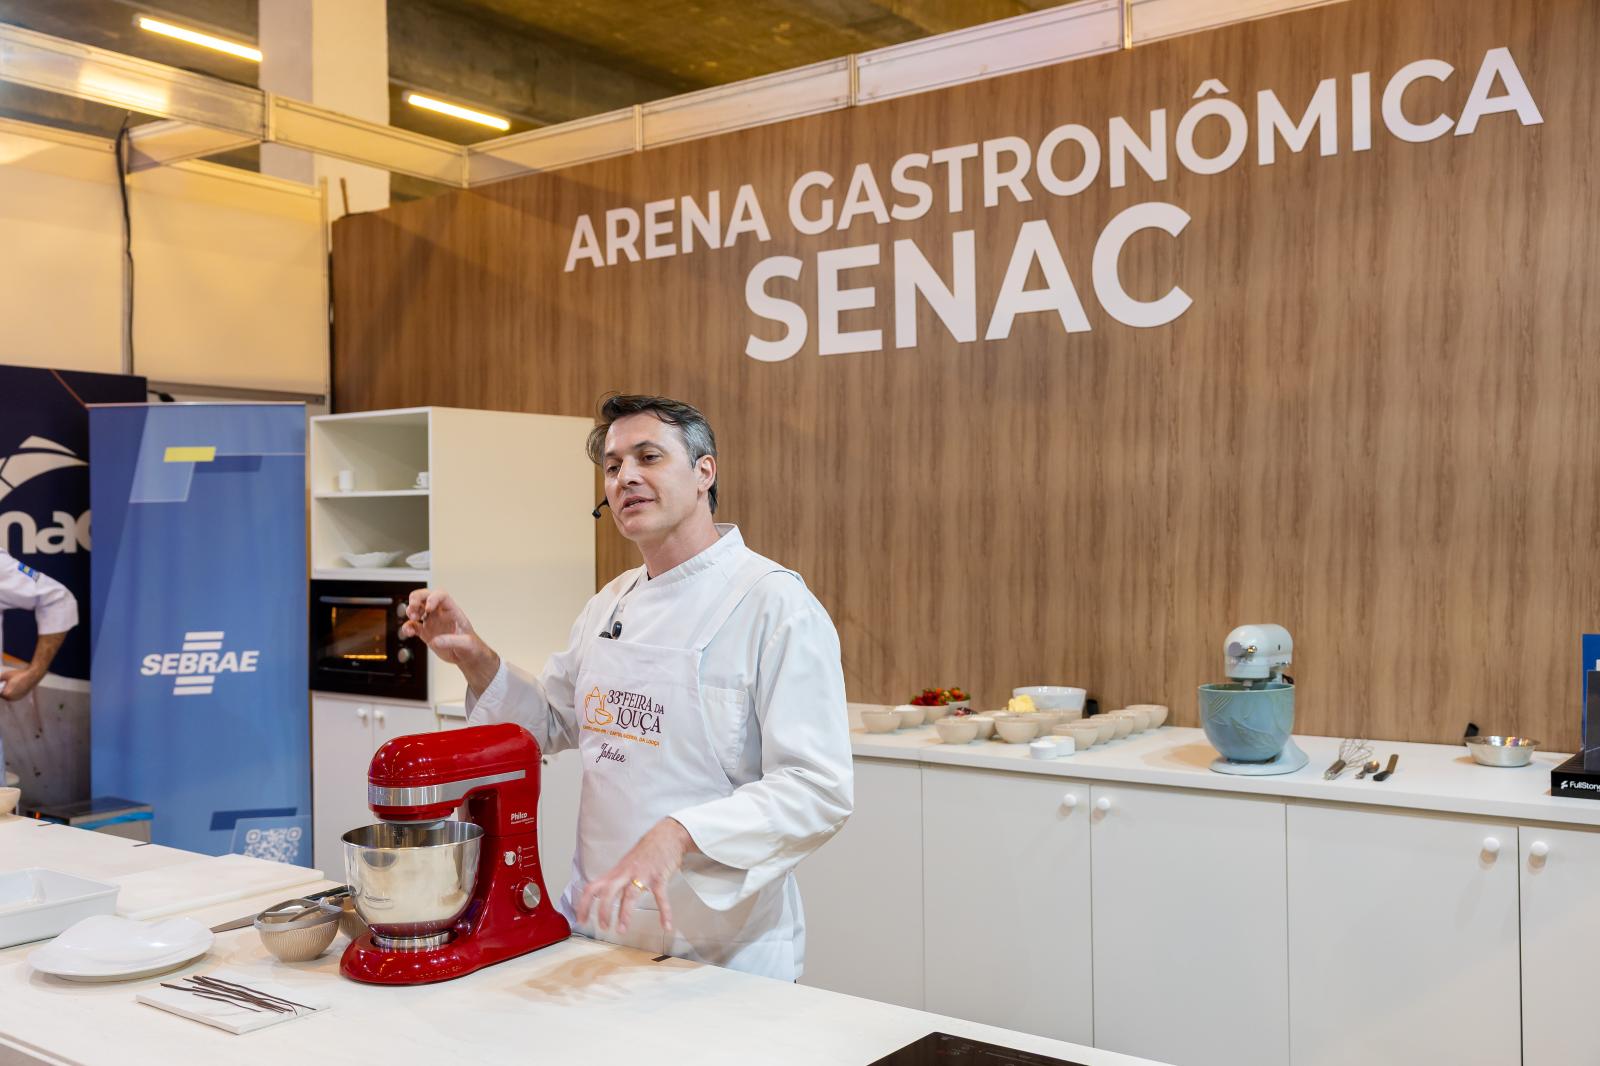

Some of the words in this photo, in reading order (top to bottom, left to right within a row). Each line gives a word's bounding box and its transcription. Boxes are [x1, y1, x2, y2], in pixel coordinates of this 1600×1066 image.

[564, 184, 772, 273] ARENA
[788, 46, 1544, 236] GASTRONÔMICA
[744, 202, 1194, 363] SENAC
[140, 650, 260, 676] SEBRAE
[622, 691, 652, 712] FEIRA
[654, 703, 665, 715] DA
[616, 707, 661, 735] LOUÇA
[511, 811, 527, 820] Philco
